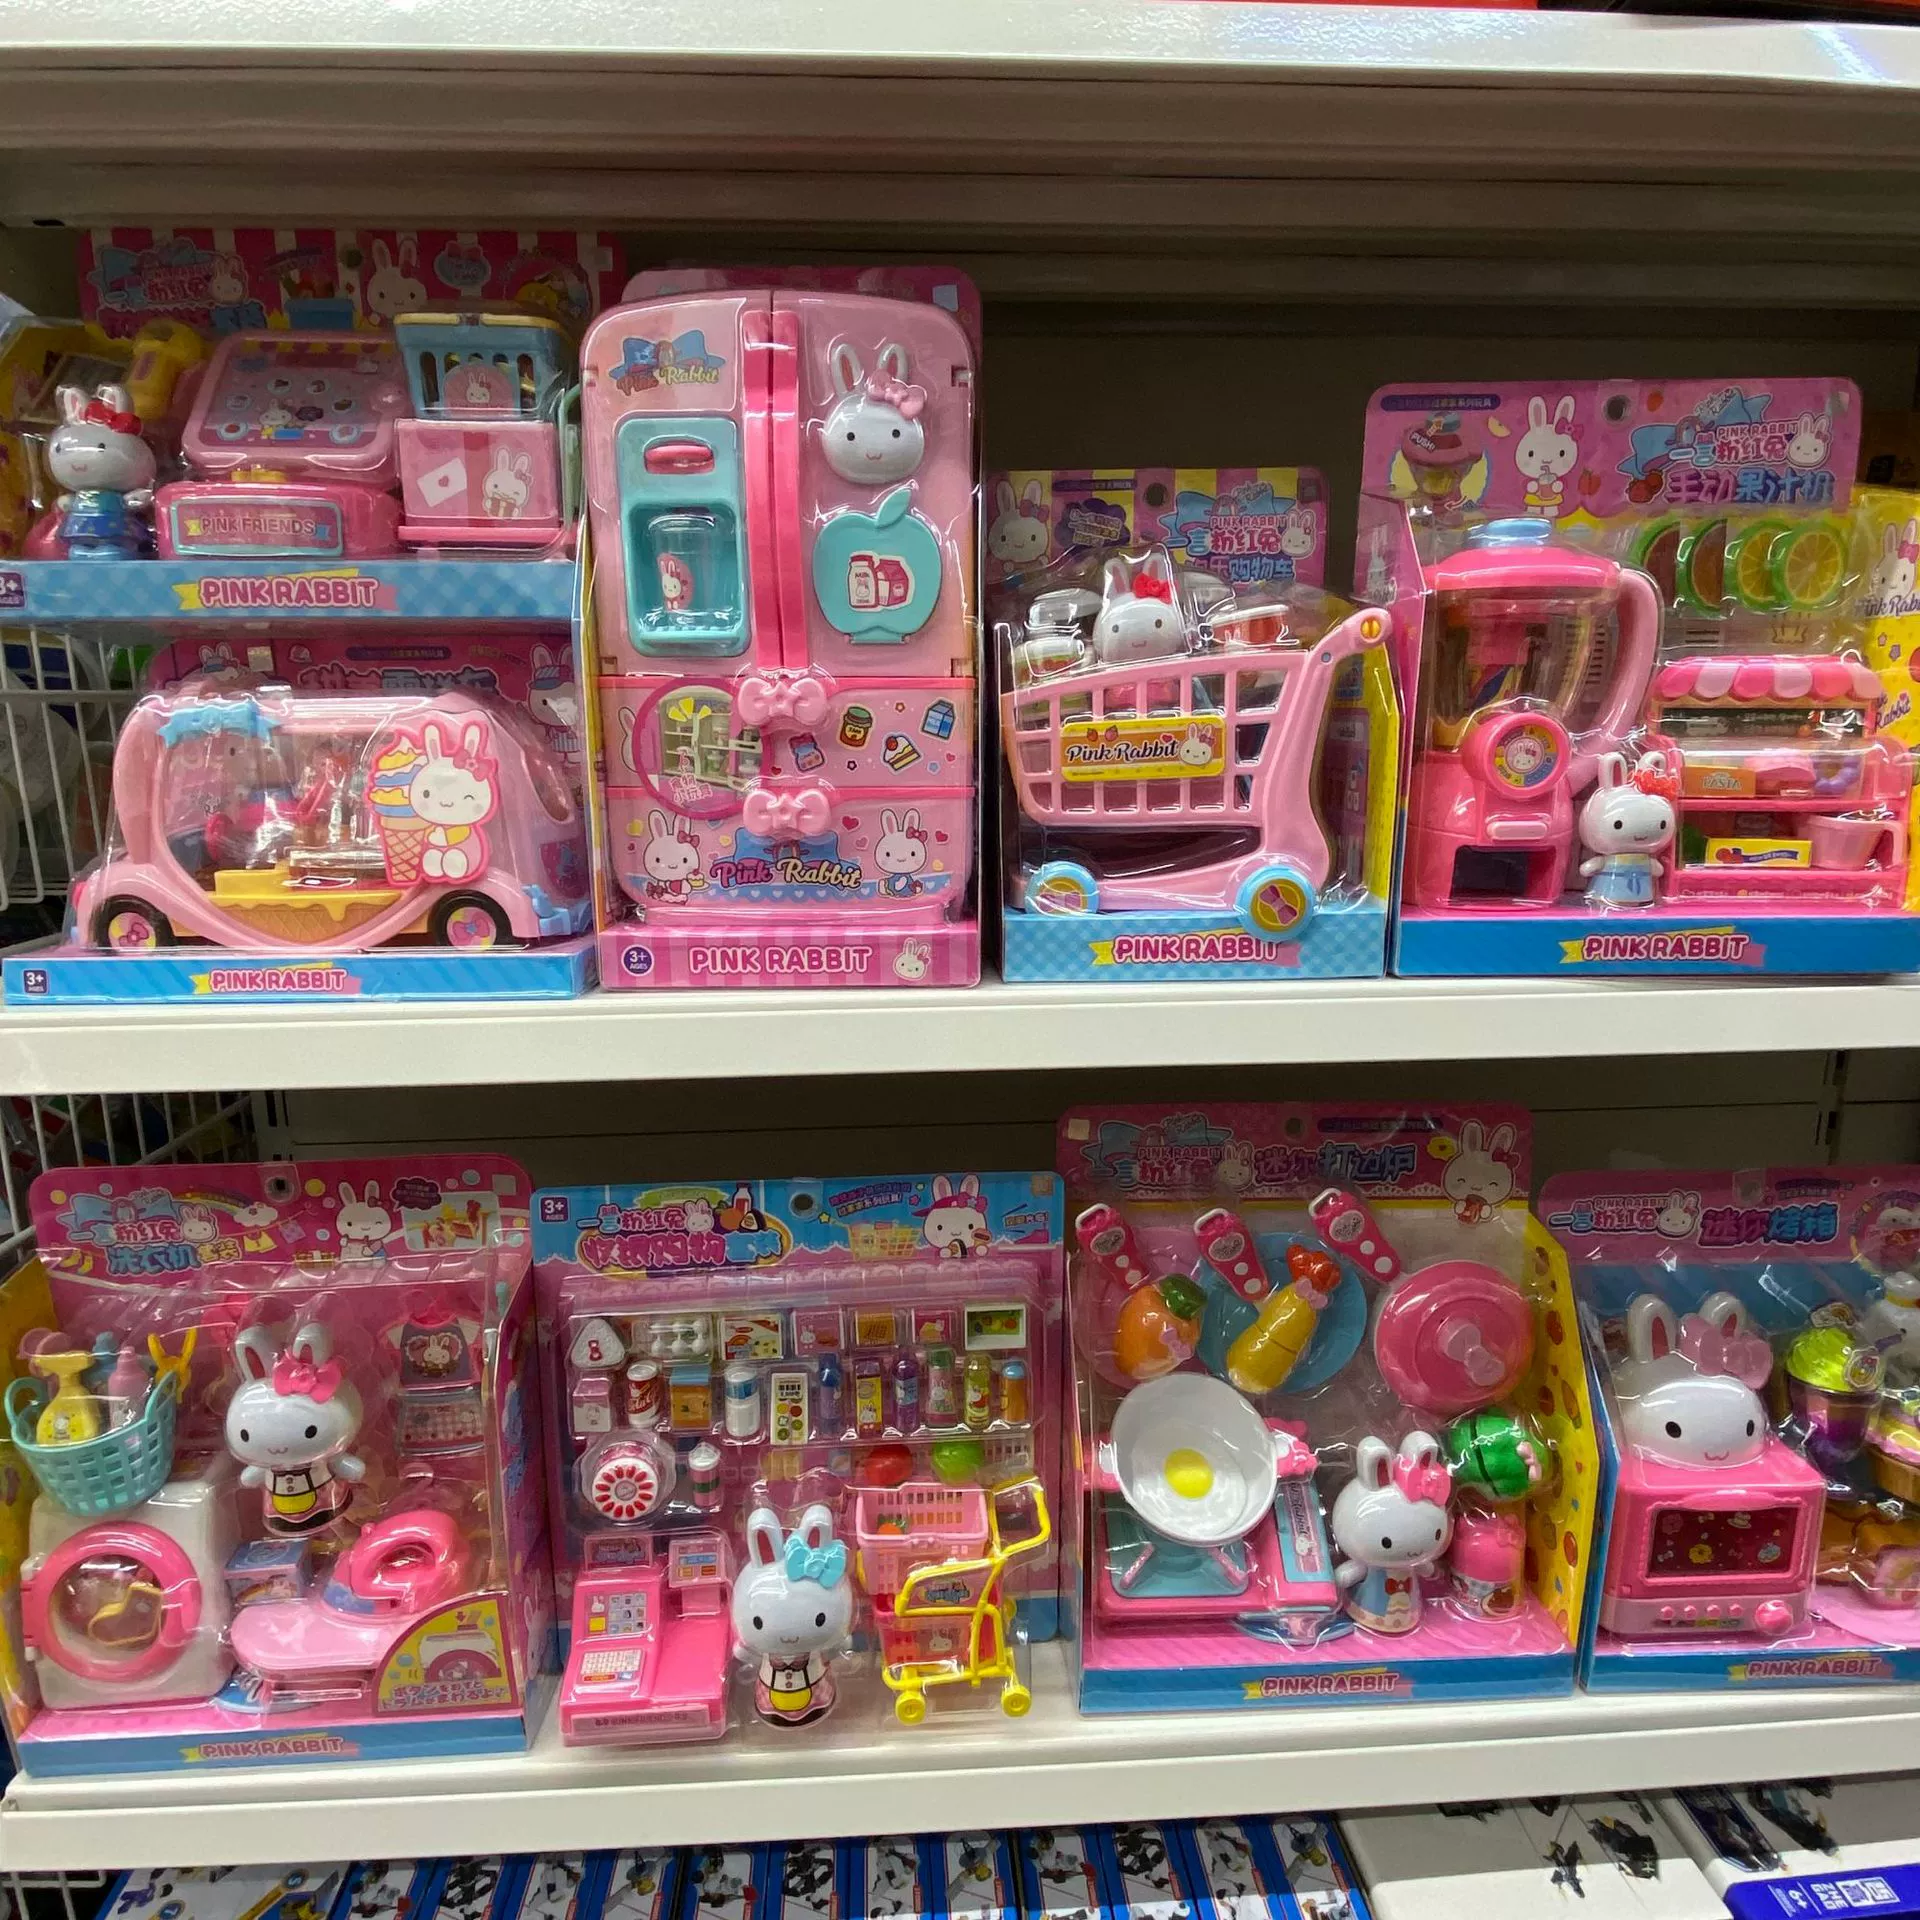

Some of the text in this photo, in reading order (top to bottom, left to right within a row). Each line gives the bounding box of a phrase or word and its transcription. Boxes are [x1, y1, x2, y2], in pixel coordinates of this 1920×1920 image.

[654, 365, 719, 386] Rabbit
[1717, 423, 1798, 438] PINK RABBIT
[201, 517, 316, 535] PINK FRIENDS
[1211, 515, 1288, 529] PINK RABBIT
[201, 576, 379, 608] PINK RABBIT
[1066, 740, 1179, 762] Pink Rabbit
[1702, 775, 1743, 790] PASTA
[710, 857, 862, 889] Pink Rabbit
[629, 950, 648, 963] 3+
[1114, 935, 1181, 963] PINK
[1584, 934, 1750, 961] PINK RABBIT
[690, 946, 872, 973] PINK RABBIT
[26, 971, 44, 986] 3+
[211, 968, 348, 992] PINK RABBIT
[544, 1199, 565, 1214] 3+
[1749, 1656, 1882, 1678] PINK RABBIT
[1262, 1673, 1399, 1697] PINK RABBIT
[200, 1736, 344, 1759] PINK RABBIT
[1788, 1889, 1808, 1909] 6+
